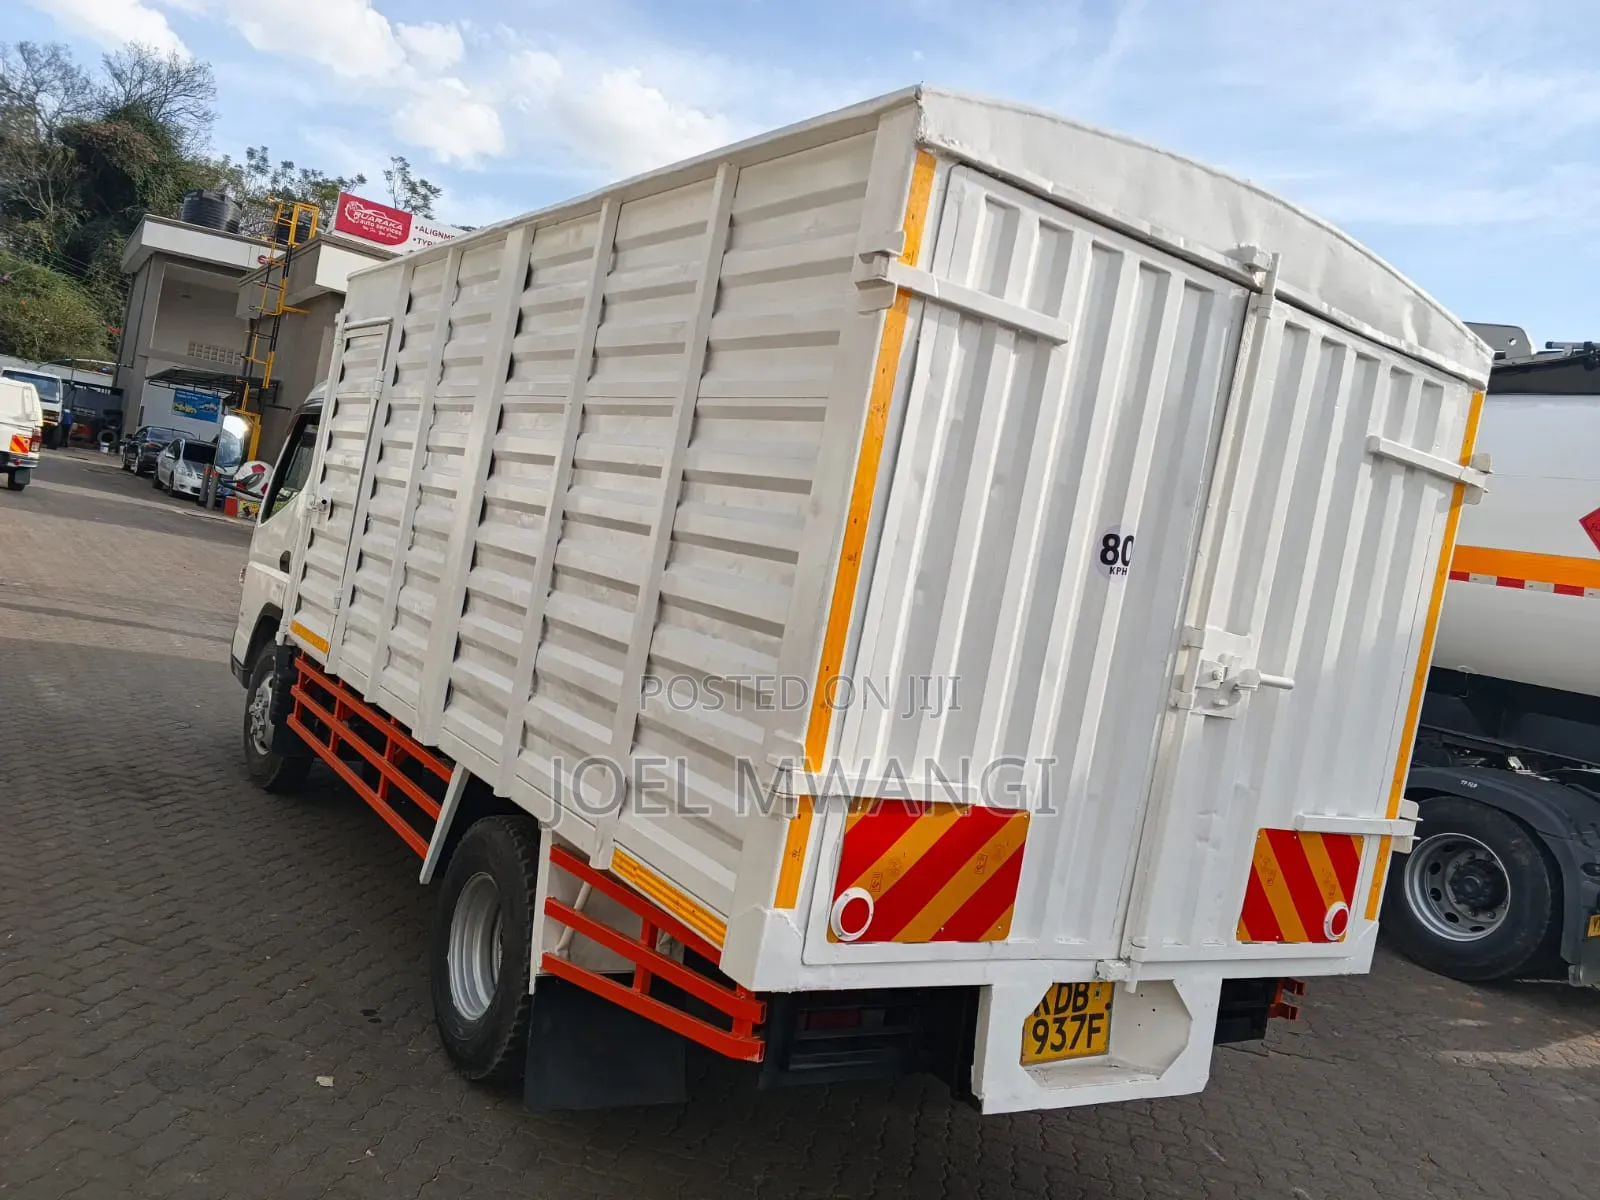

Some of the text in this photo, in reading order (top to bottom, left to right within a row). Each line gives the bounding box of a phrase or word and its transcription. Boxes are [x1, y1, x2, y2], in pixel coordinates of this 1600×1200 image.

[1100, 533, 1134, 567] 80
[1109, 566, 1128, 576] KPH
[1032, 1012, 1105, 1055] 937F
